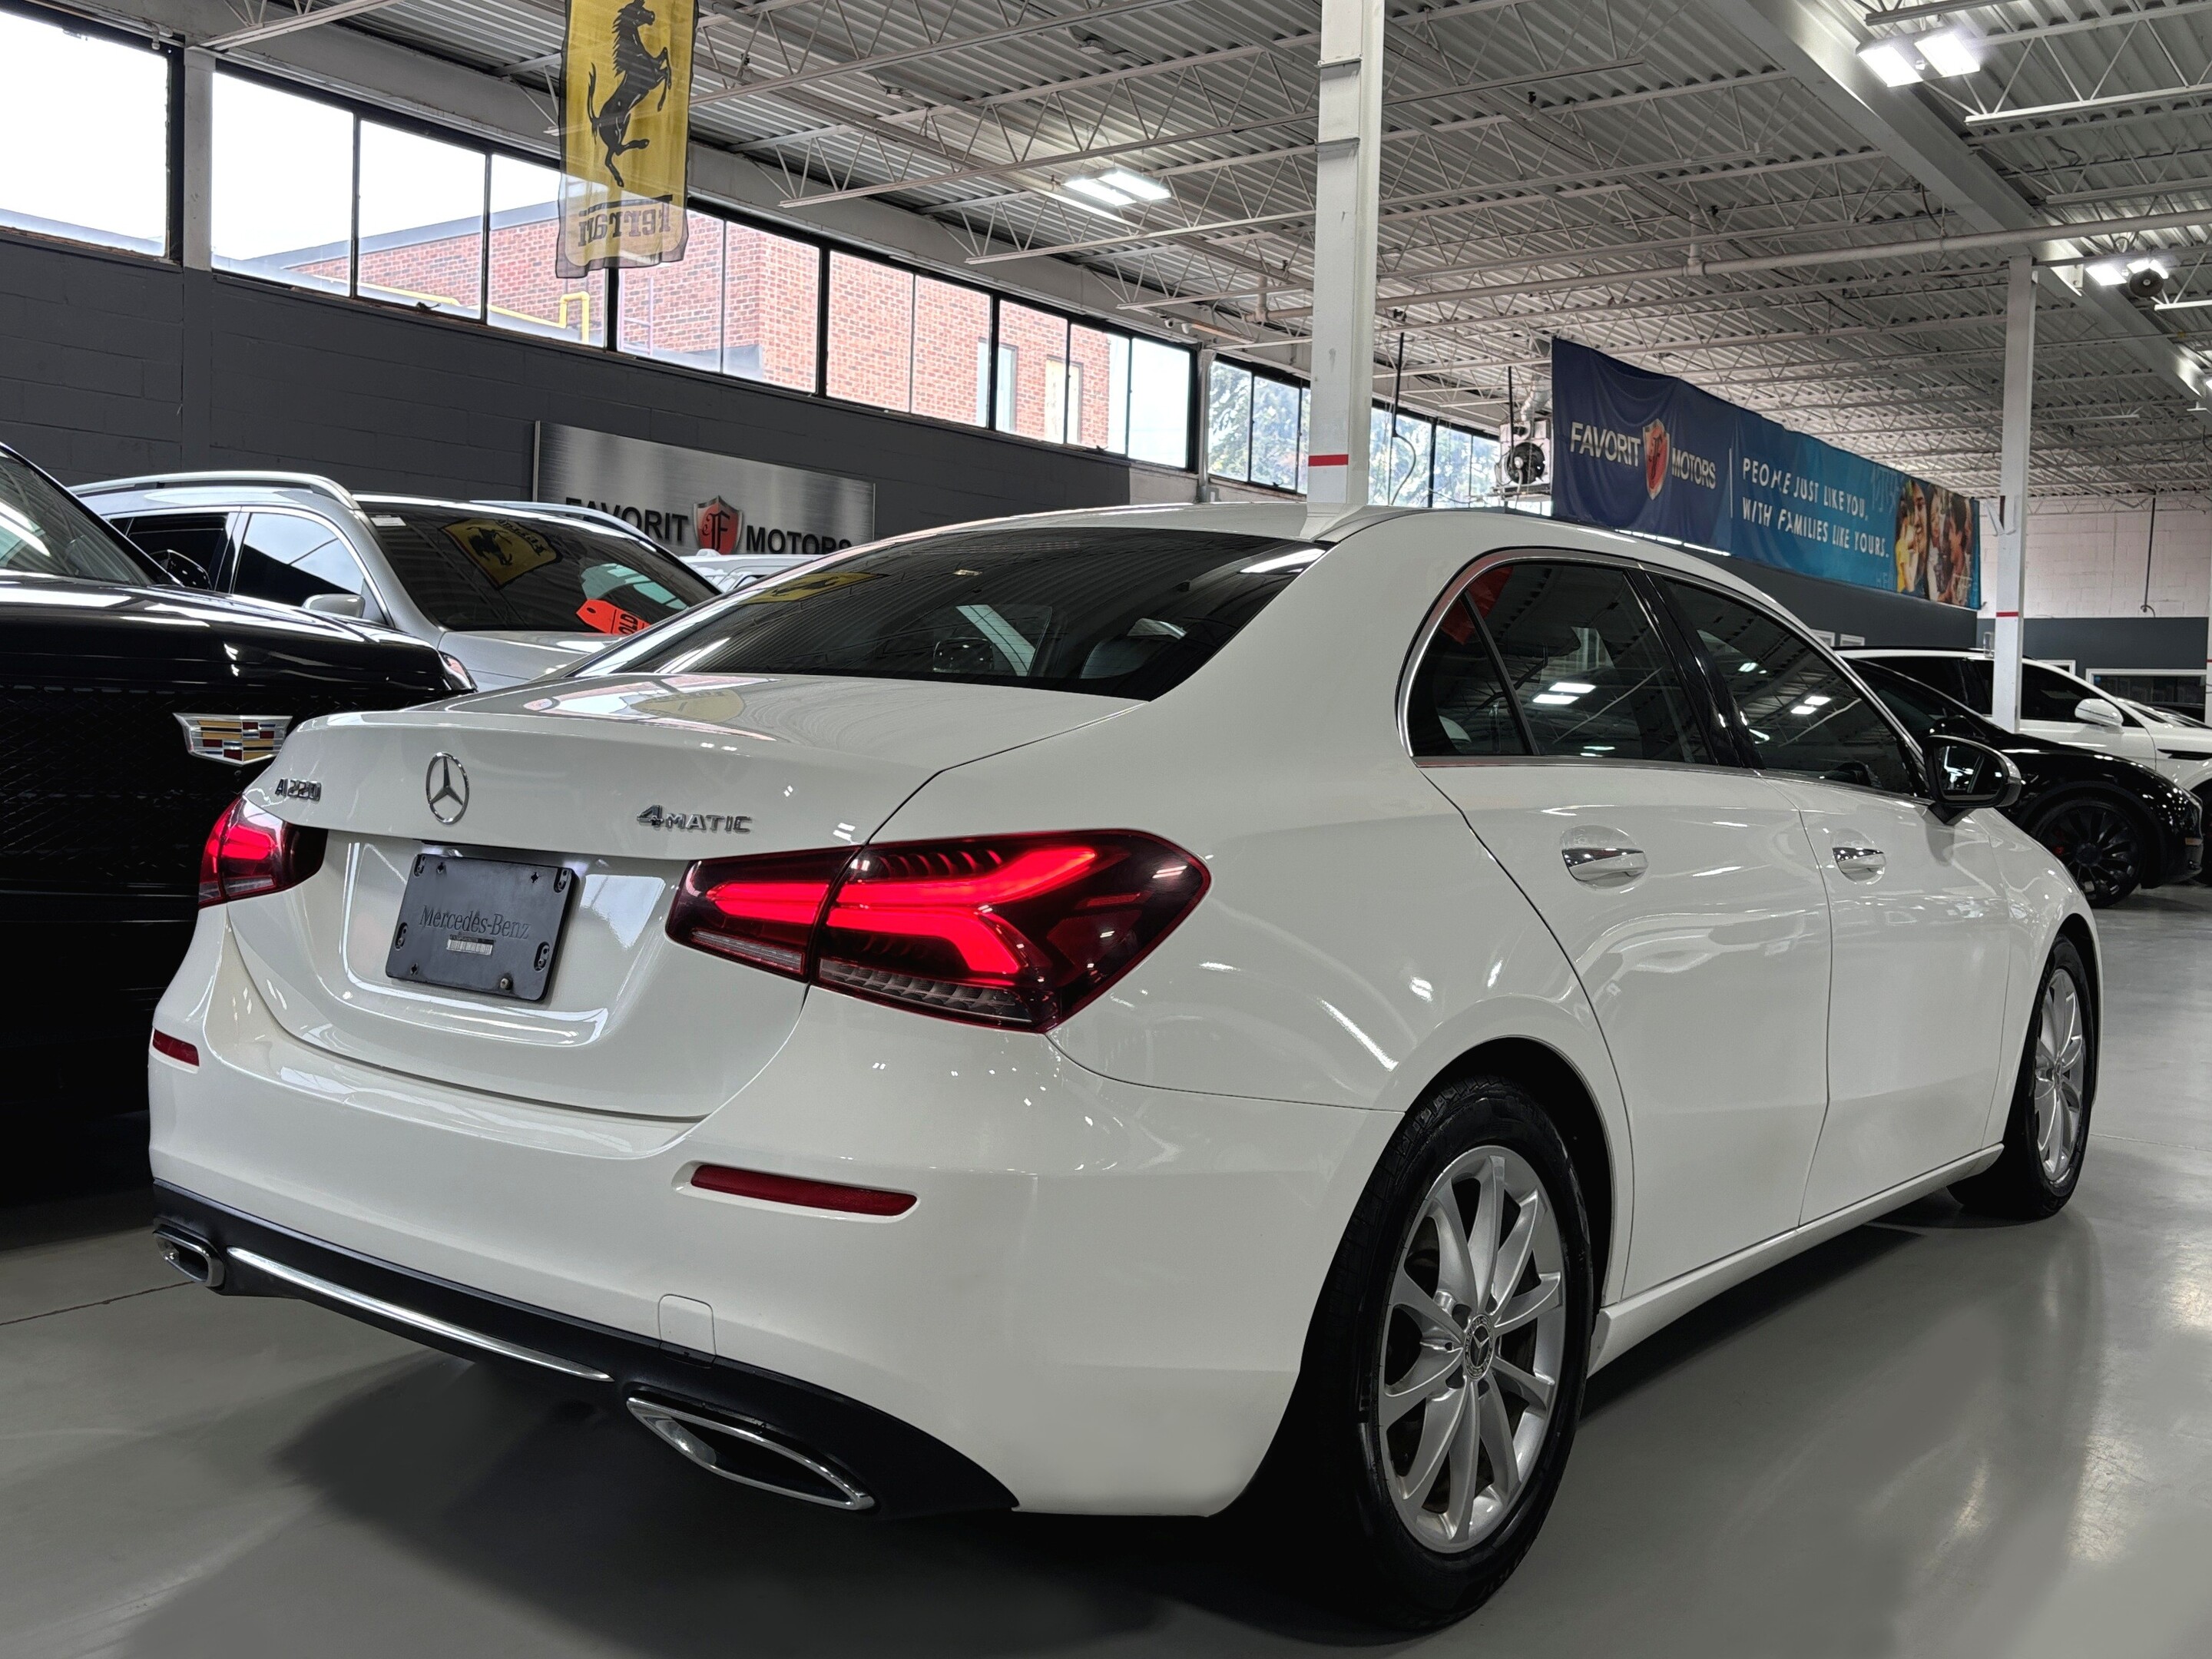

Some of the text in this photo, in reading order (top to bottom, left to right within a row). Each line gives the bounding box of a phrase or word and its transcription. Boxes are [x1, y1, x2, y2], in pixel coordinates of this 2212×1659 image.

[1570, 422, 1641, 467] FAVORIT
[1671, 448, 1717, 490] MOTORS
[1793, 476, 1819, 503] JUST
[1823, 485, 1844, 511] LIKE
[1742, 497, 1889, 558] WITH FAMILIES LIKE YOURS.
[618, 614, 638, 634] OLD
[637, 804, 753, 833] 4MATIC
[420, 905, 531, 939] Mercedes-Benz
